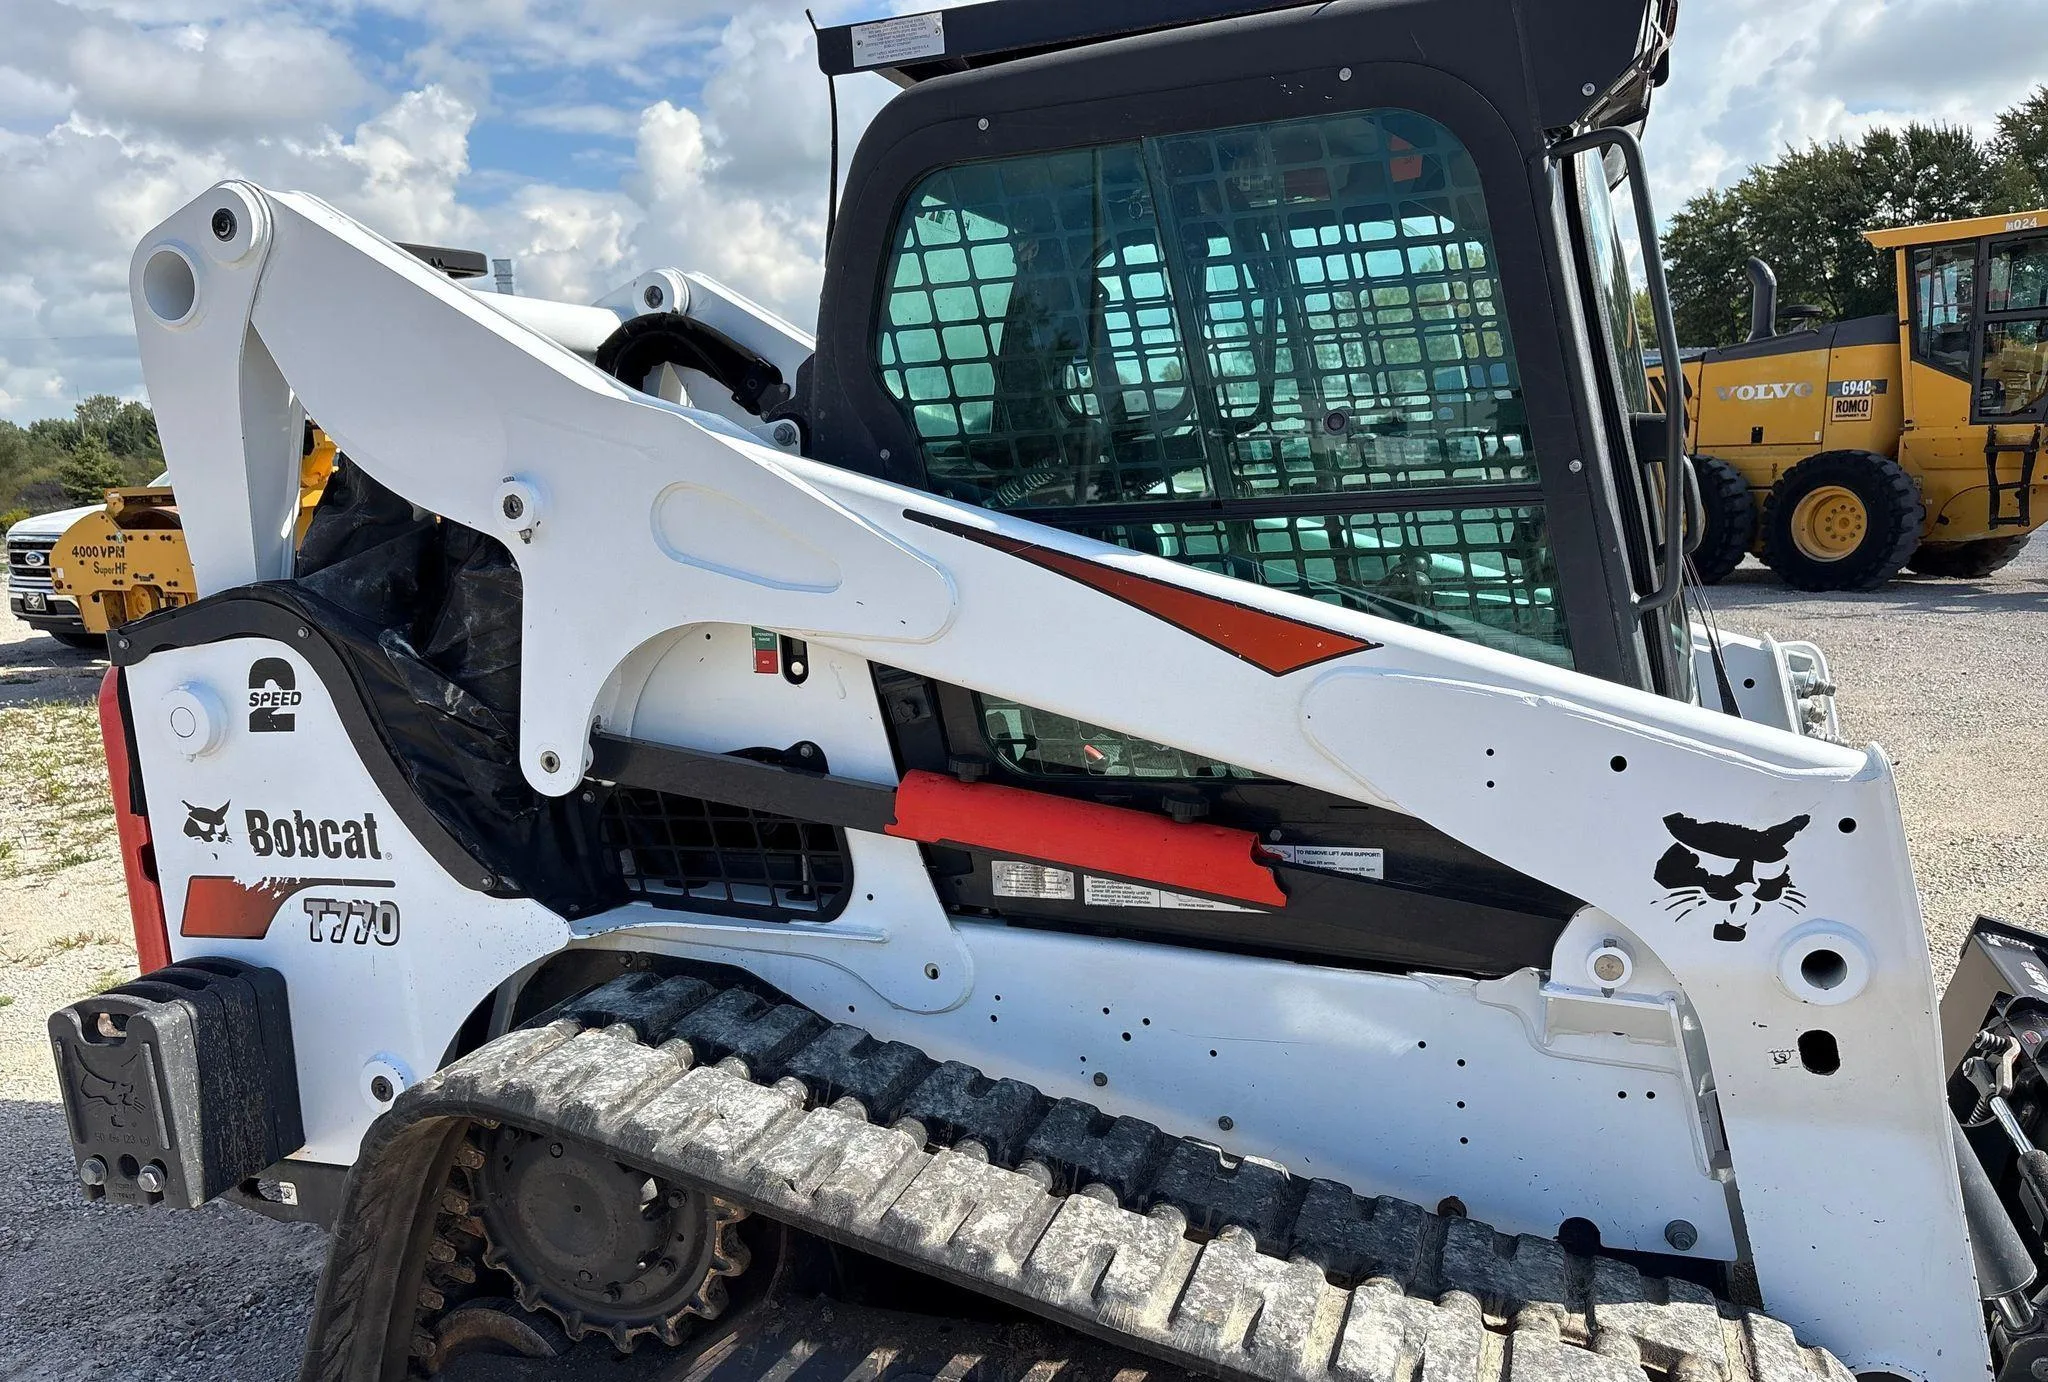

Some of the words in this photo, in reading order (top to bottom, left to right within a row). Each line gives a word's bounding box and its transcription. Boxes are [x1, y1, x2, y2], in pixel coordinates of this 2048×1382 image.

[1714, 382, 1813, 401] VOLVO
[1841, 380, 1871, 395] G940
[1836, 400, 1868, 413] ROMCO
[71, 545, 99, 558] 4000
[248, 691, 302, 707] SPEED
[244, 809, 382, 860] Bobcat
[303, 898, 400, 946] T770
